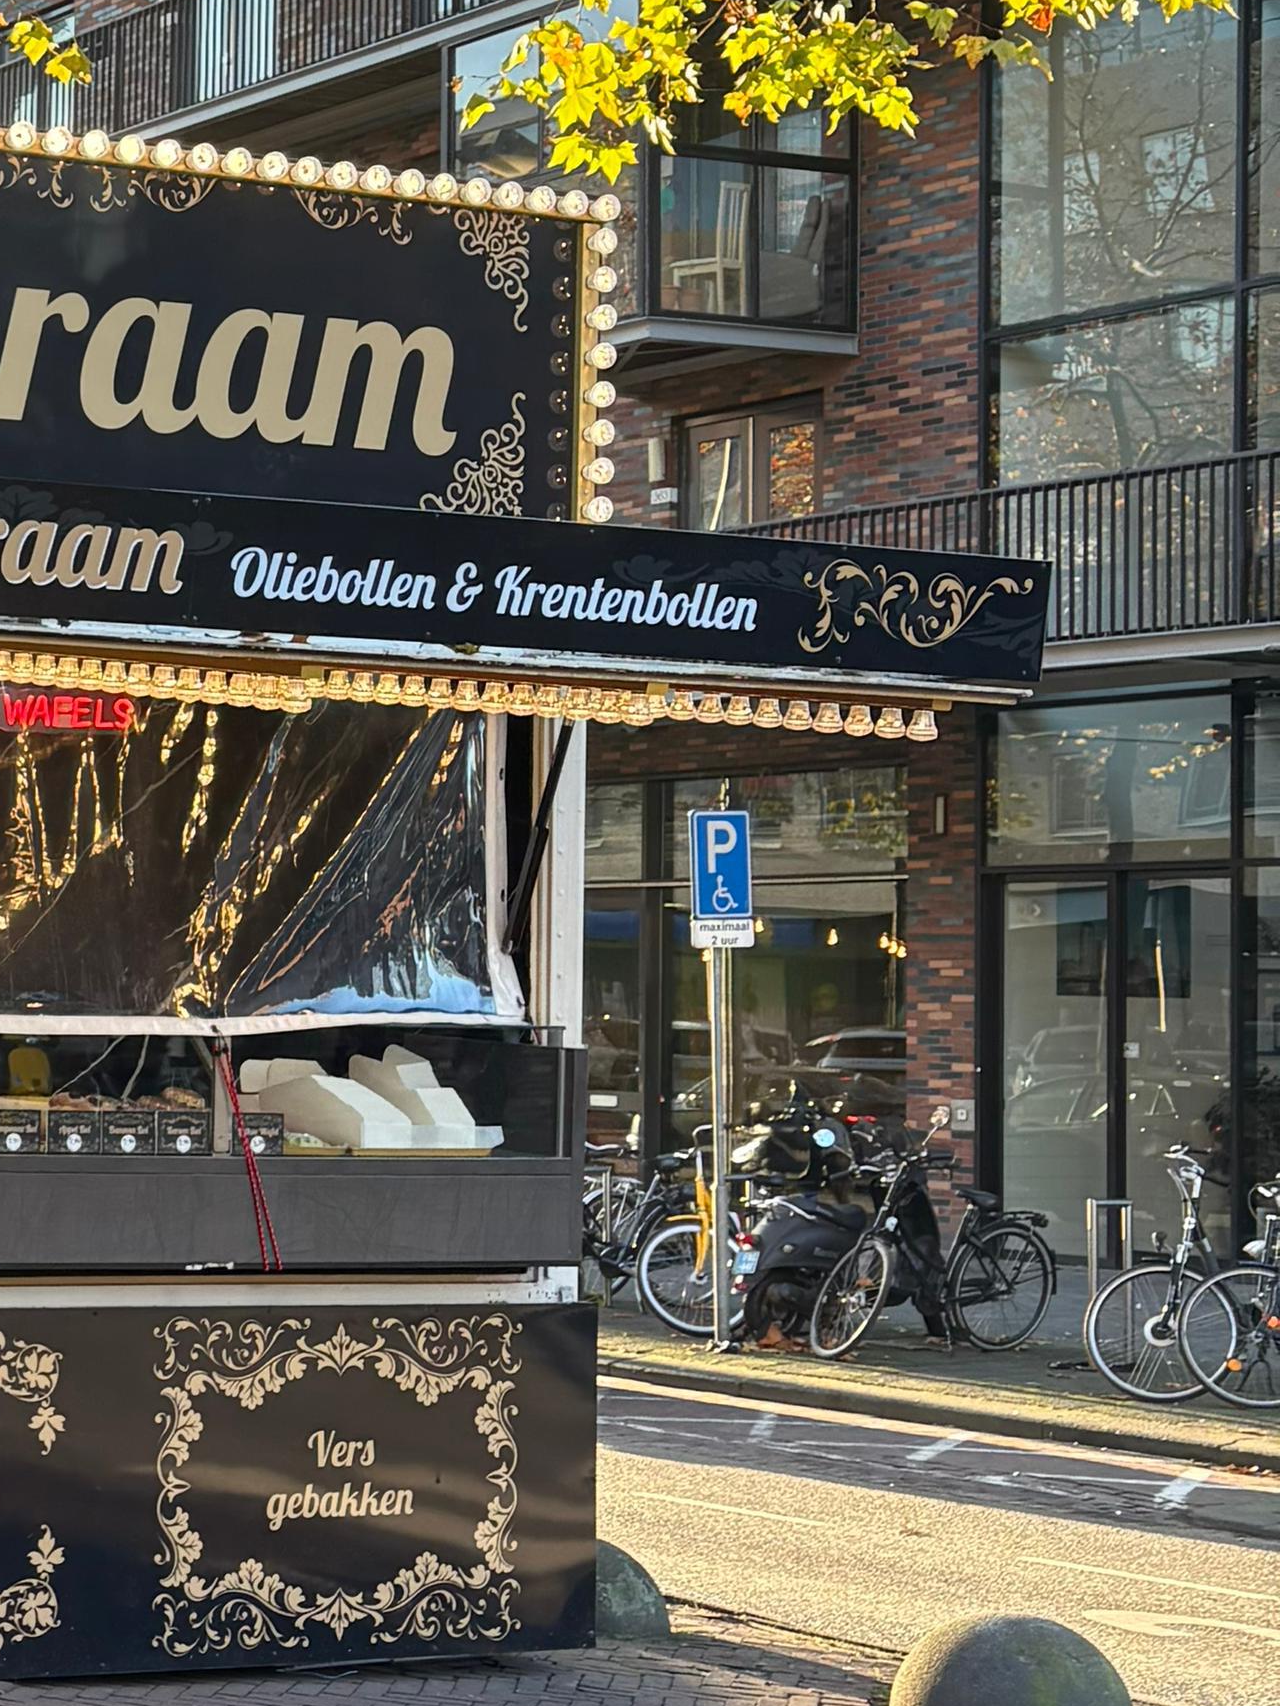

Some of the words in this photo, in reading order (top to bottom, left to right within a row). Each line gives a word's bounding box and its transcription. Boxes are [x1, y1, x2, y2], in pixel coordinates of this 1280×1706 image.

[230, 546, 436, 610] Oliebollen
[445, 561, 483, 613] &
[494, 564, 758, 632] Krentenbollen
[3, 694, 135, 729] WAFELS
[706, 820, 737, 873] P
[699, 920, 750, 932] maximaal
[711, 935, 718, 945] 2
[720, 936, 739, 945] uur
[307, 1430, 375, 1468] Vers
[266, 1481, 414, 1531] gebakken
